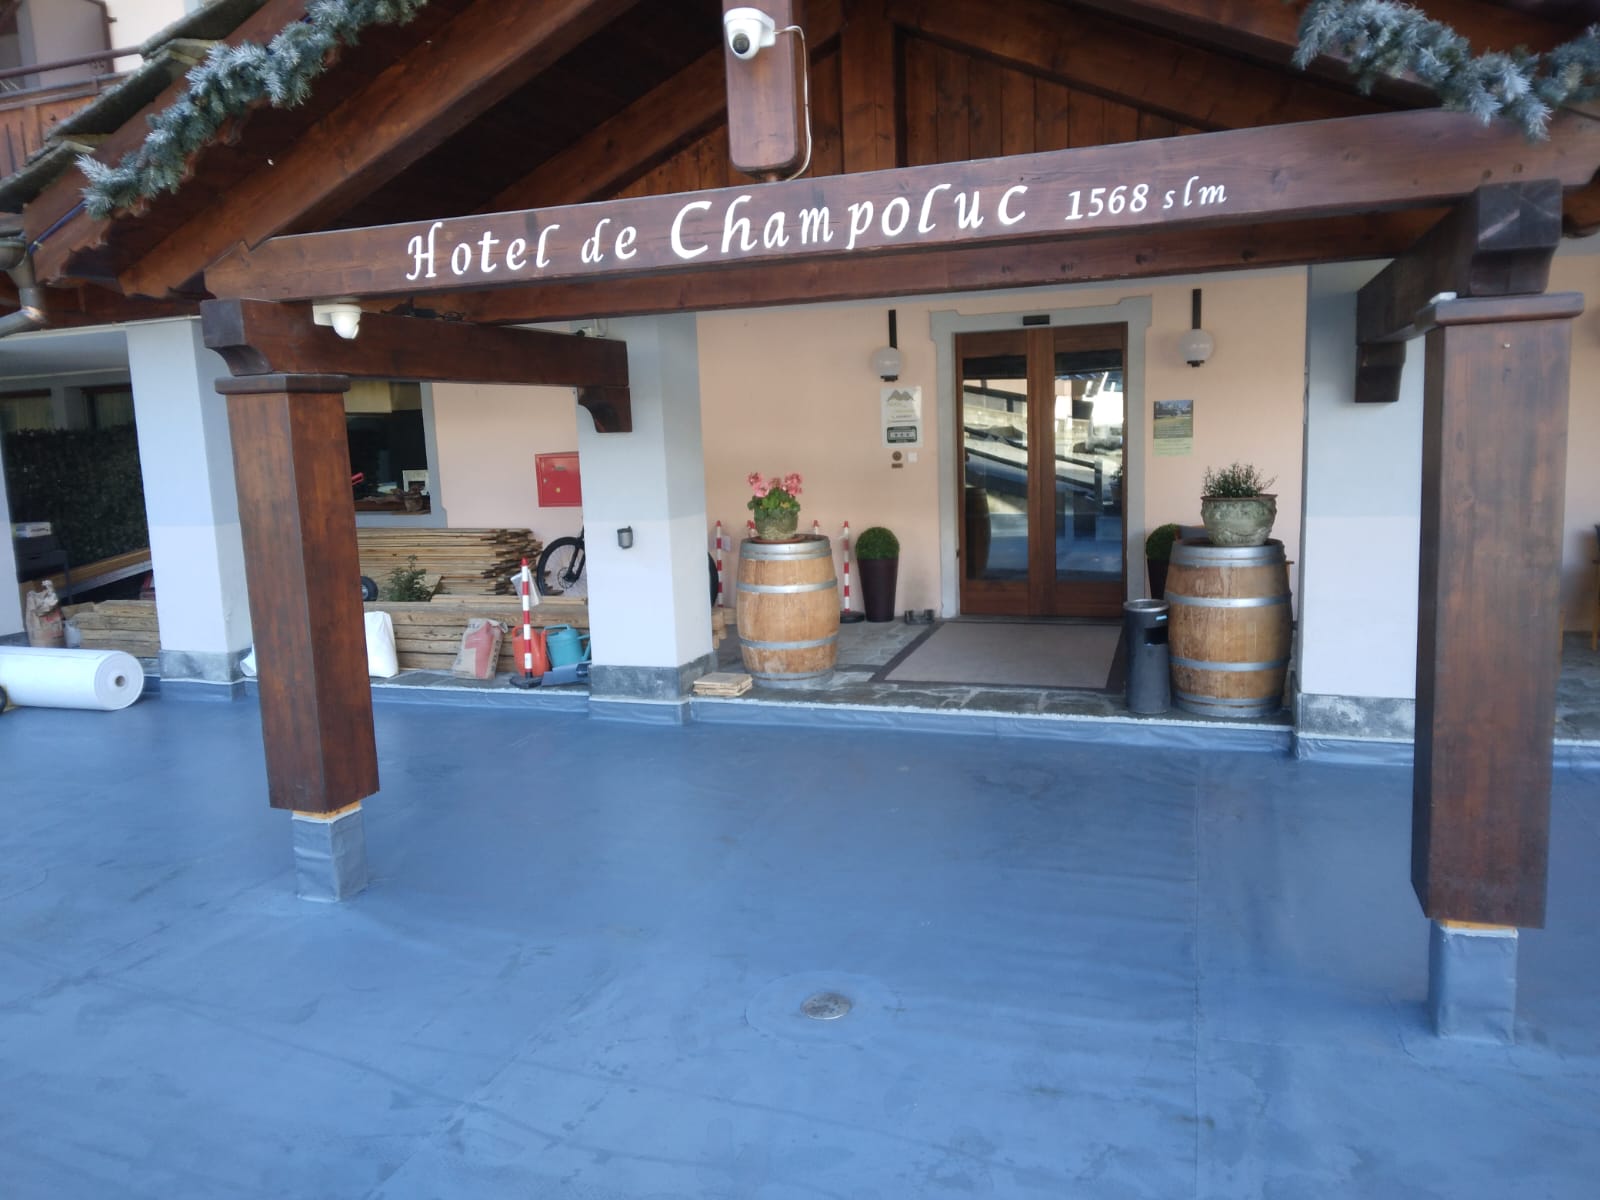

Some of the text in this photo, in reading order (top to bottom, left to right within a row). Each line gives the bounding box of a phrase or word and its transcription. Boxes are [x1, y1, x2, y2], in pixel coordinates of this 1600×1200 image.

[406, 175, 1227, 281] Hotel de Champoluc 1568 slm
